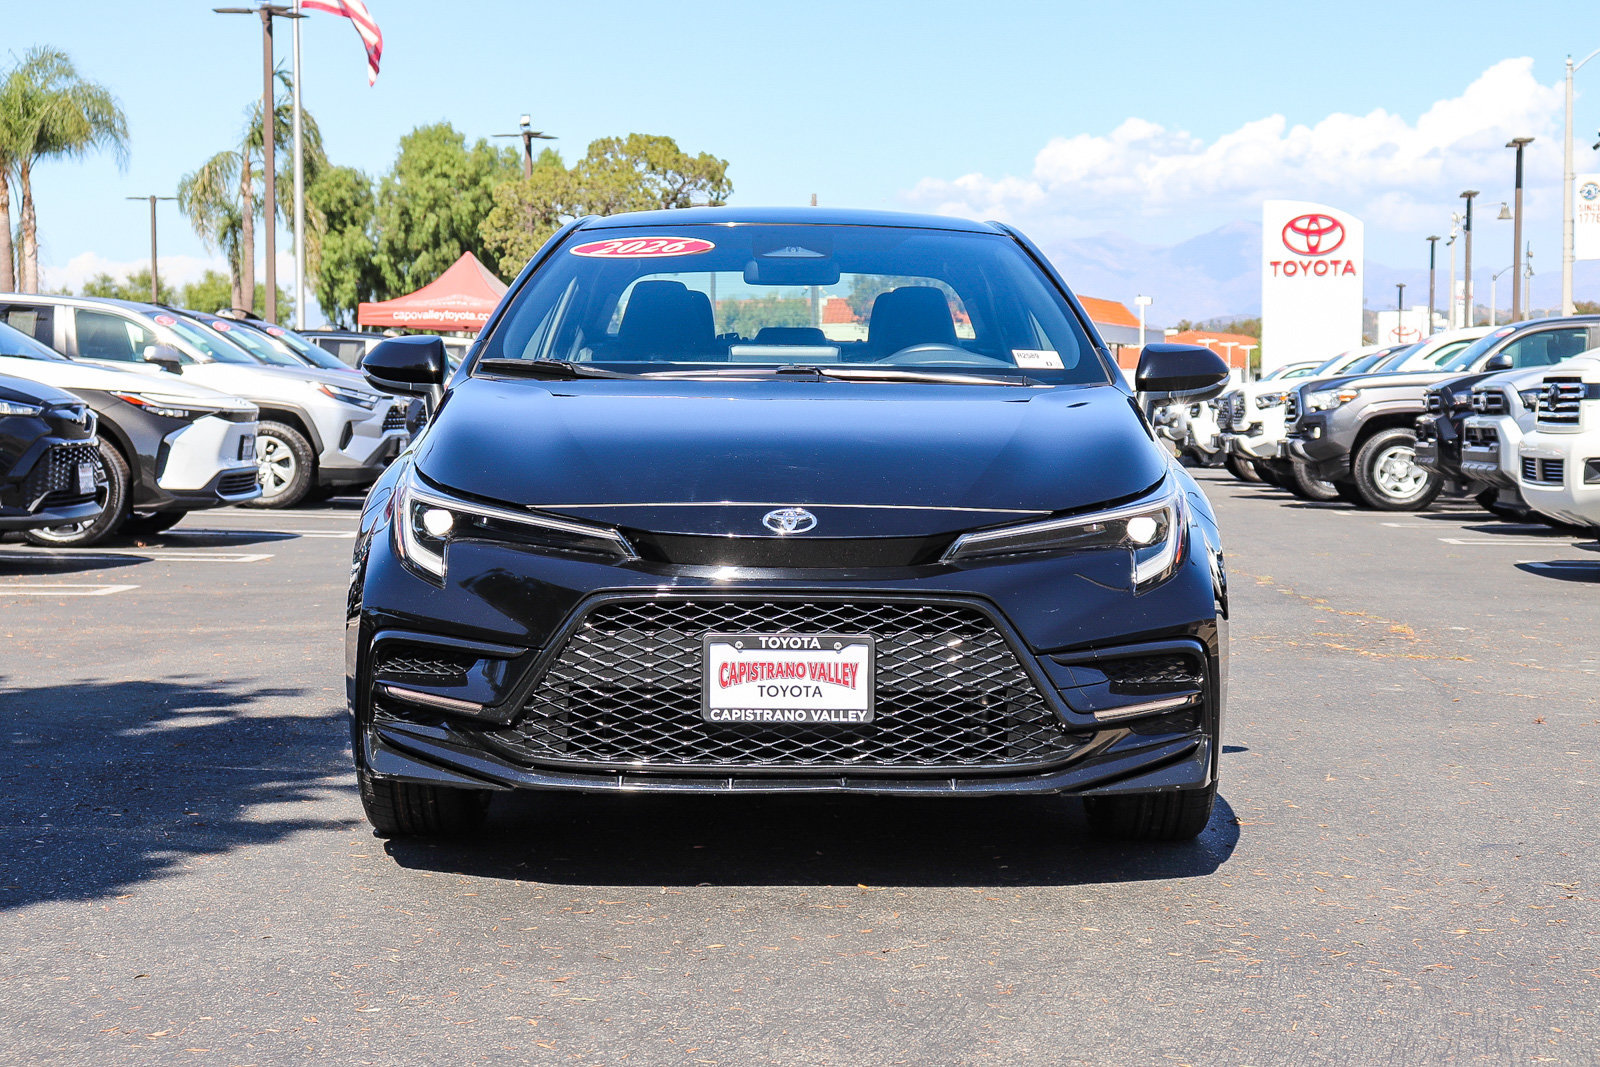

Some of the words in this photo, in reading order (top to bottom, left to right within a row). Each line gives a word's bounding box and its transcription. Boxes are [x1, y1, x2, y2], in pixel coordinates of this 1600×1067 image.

[590, 240, 695, 254] 2026
[1270, 260, 1357, 277] TOYOTA
[393, 310, 491, 322] capovalleytoyota.co
[758, 637, 821, 649] TOYOTA
[719, 661, 807, 689] CAPISTRANO
[808, 661, 860, 690] VALLEY
[757, 685, 823, 698] TOYOTA
[710, 709, 807, 721] CAPISTRANO
[811, 709, 868, 722] VALLEY
